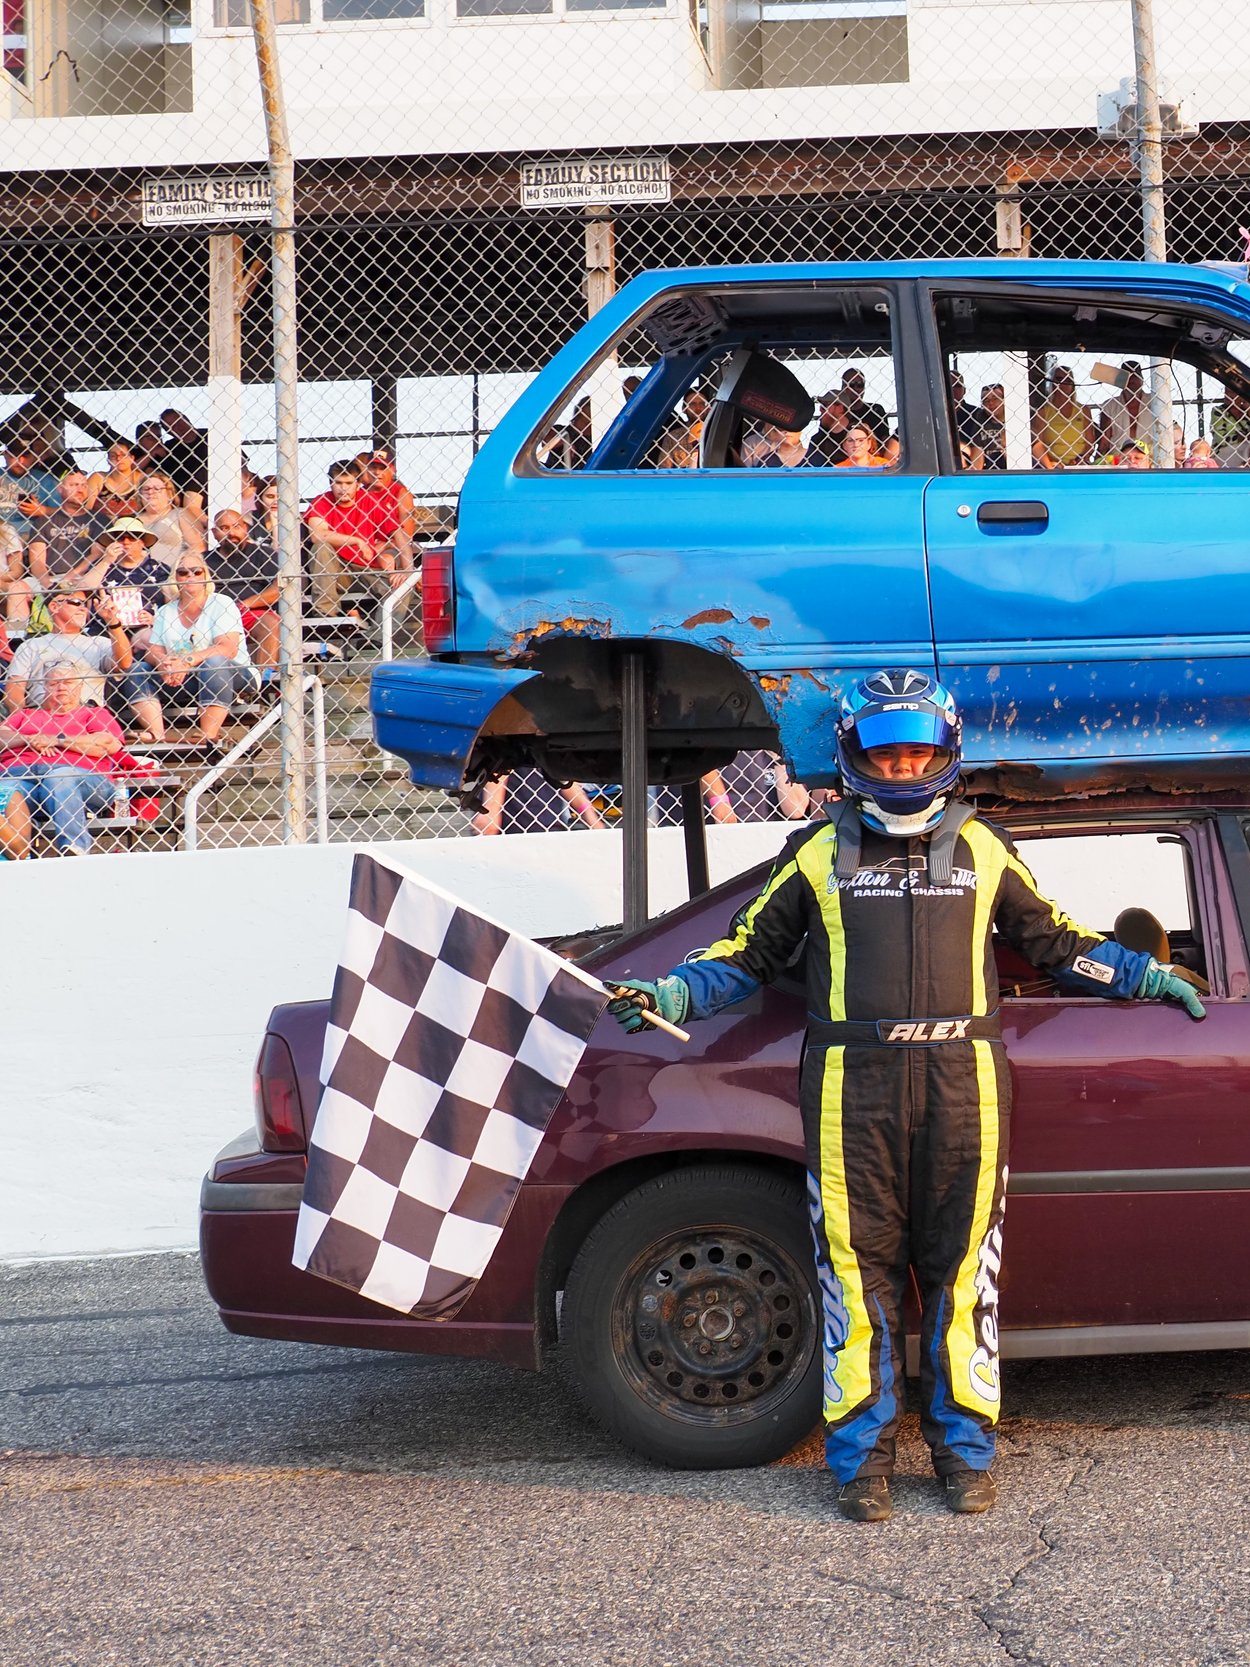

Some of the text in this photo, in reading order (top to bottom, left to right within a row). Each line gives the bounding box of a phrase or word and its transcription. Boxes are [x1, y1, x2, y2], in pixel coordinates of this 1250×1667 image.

[525, 161, 666, 185] FAMILY SECTION
[148, 182, 207, 201] FAMILY
[526, 190, 540, 200] NO
[543, 186, 591, 199] SMOKING
[600, 185, 615, 196] NO
[617, 183, 663, 195] ALCOHOL
[148, 204, 163, 216] NO
[166, 203, 215, 216] SMOKING
[224, 203, 238, 213] NO
[241, 200, 272, 212] ALCO
[853, 887, 965, 898] RACING CHASSIS
[886, 1020, 971, 1041] ALEX
